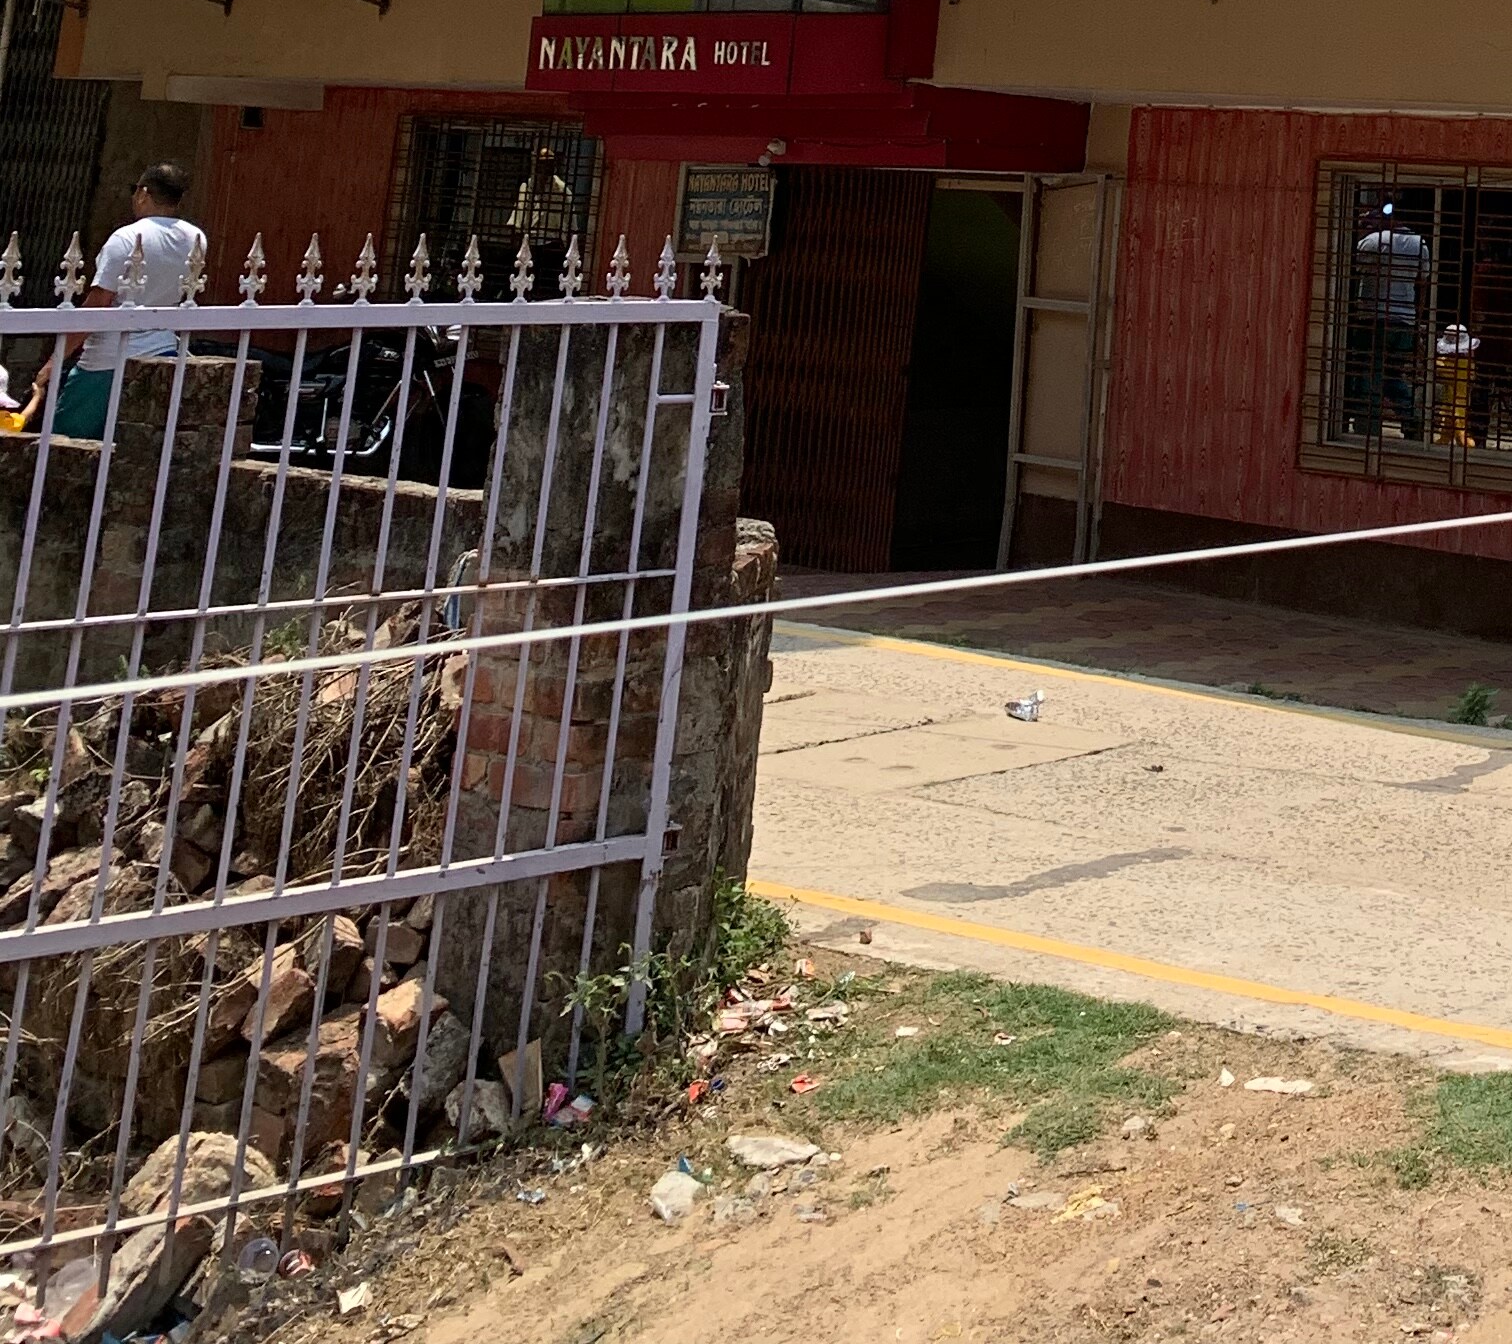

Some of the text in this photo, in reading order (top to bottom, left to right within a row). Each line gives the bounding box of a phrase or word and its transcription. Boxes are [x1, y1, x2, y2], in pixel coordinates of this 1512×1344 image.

[538, 36, 770, 71] NAYANTARA HOTEL
[741, 173, 769, 192] HOTEL
